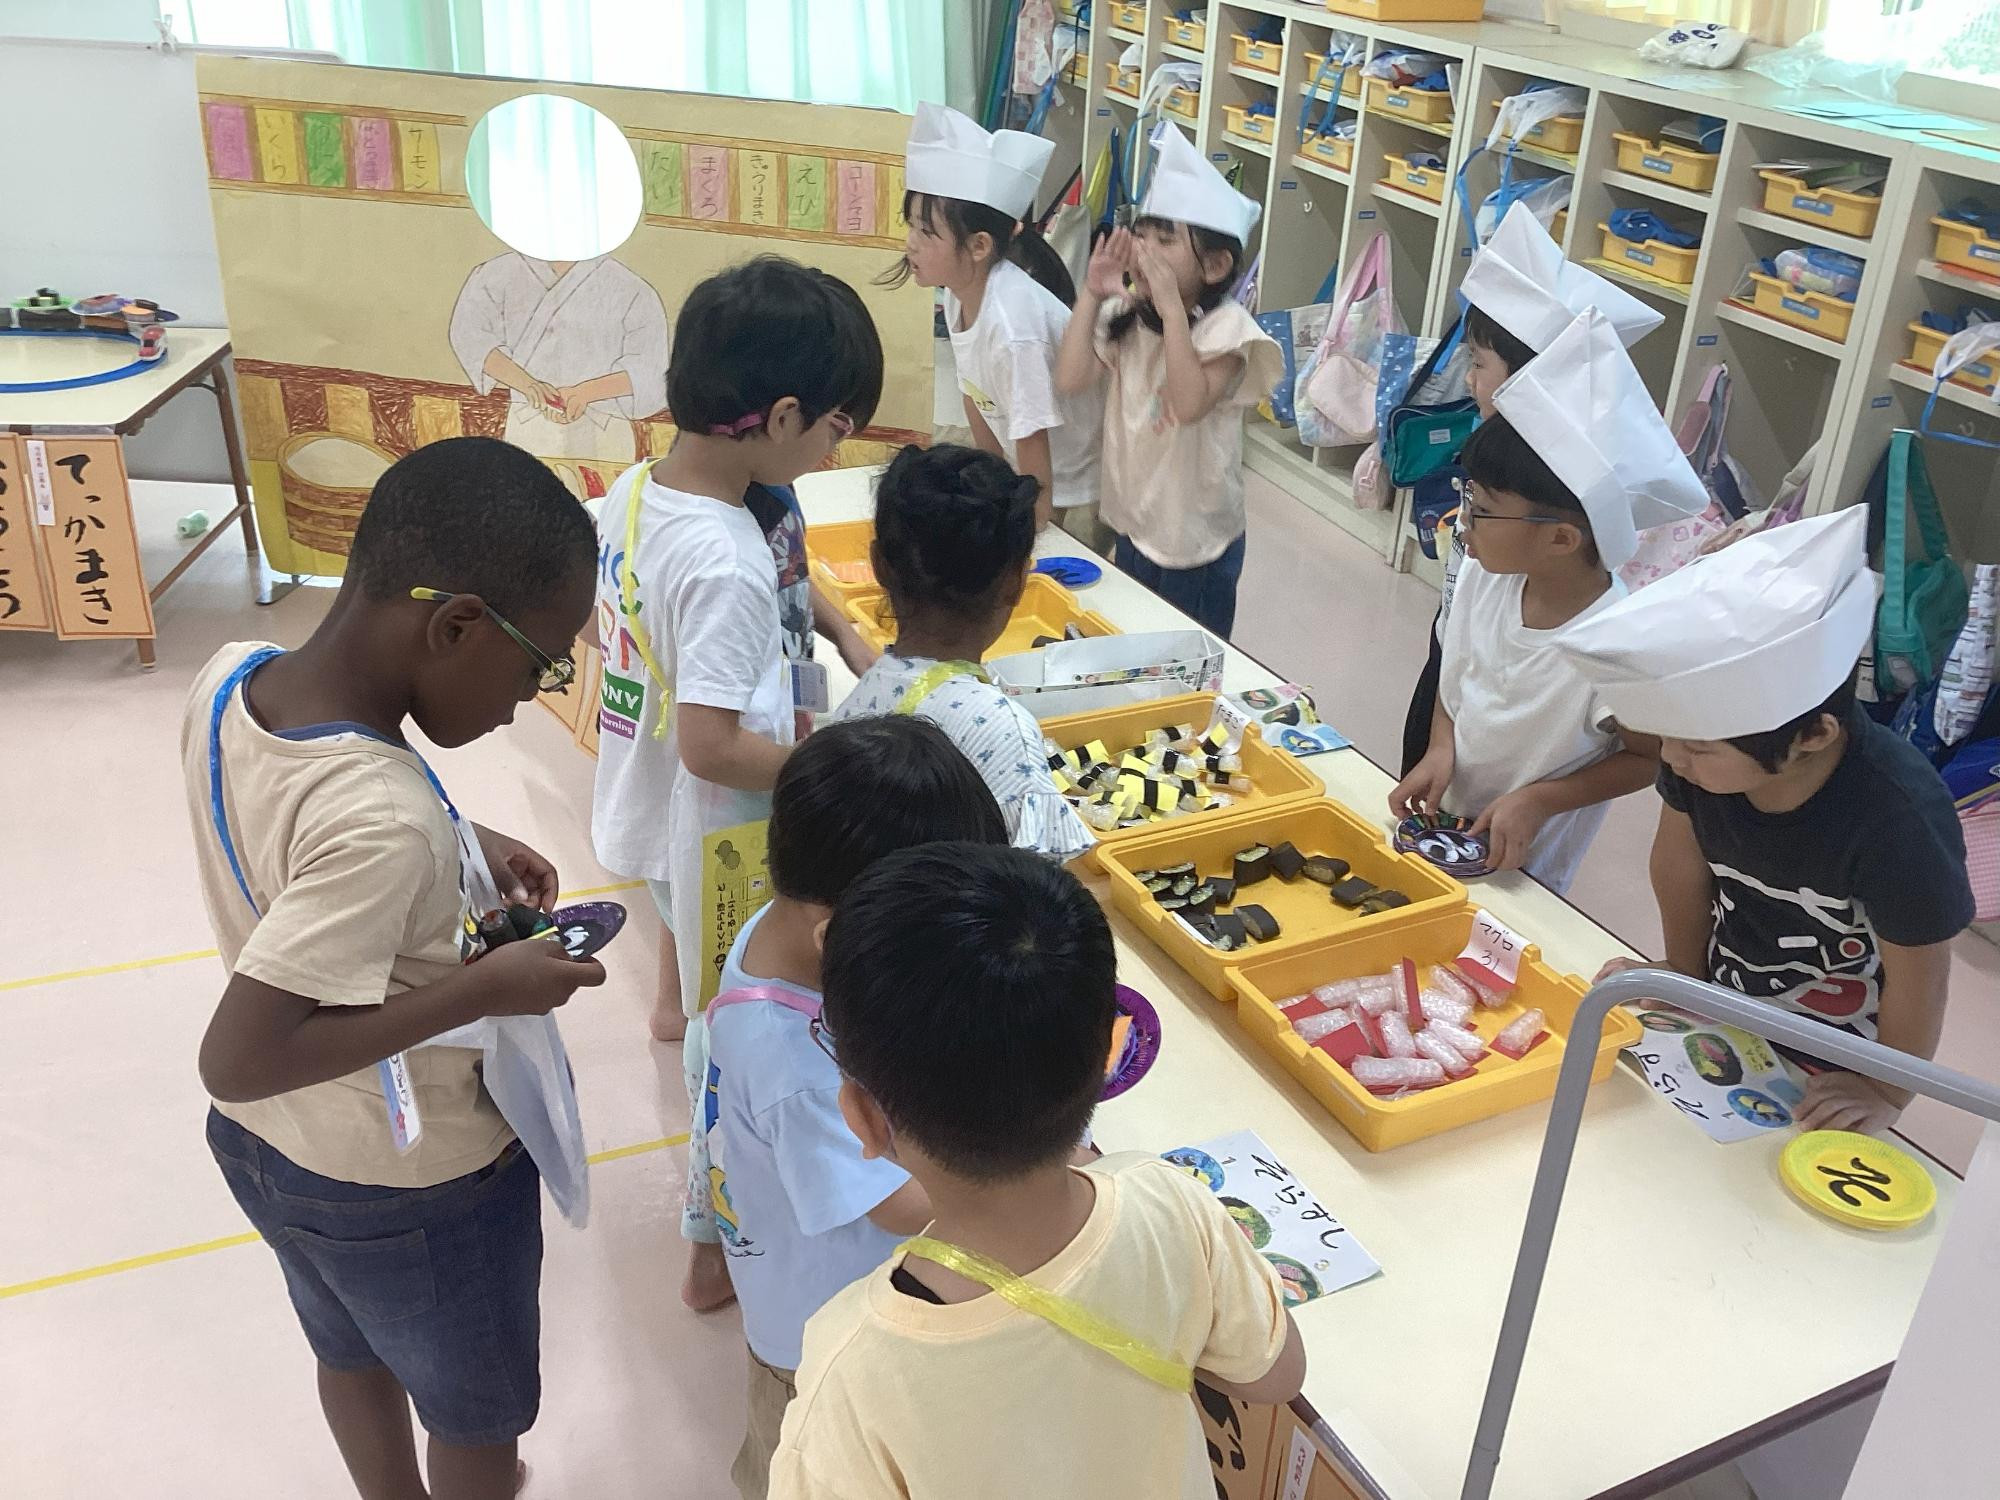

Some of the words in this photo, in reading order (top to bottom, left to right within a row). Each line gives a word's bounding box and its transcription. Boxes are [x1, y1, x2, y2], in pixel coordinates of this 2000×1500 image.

[263, 115, 287, 179] いくら
[650, 151, 674, 200] たい
[847, 166, 863, 231] コーンマヨ
[55, 453, 113, 626] てっかまき
[1479, 921, 1514, 952] マグロ
[1480, 950, 1501, 972] 31
